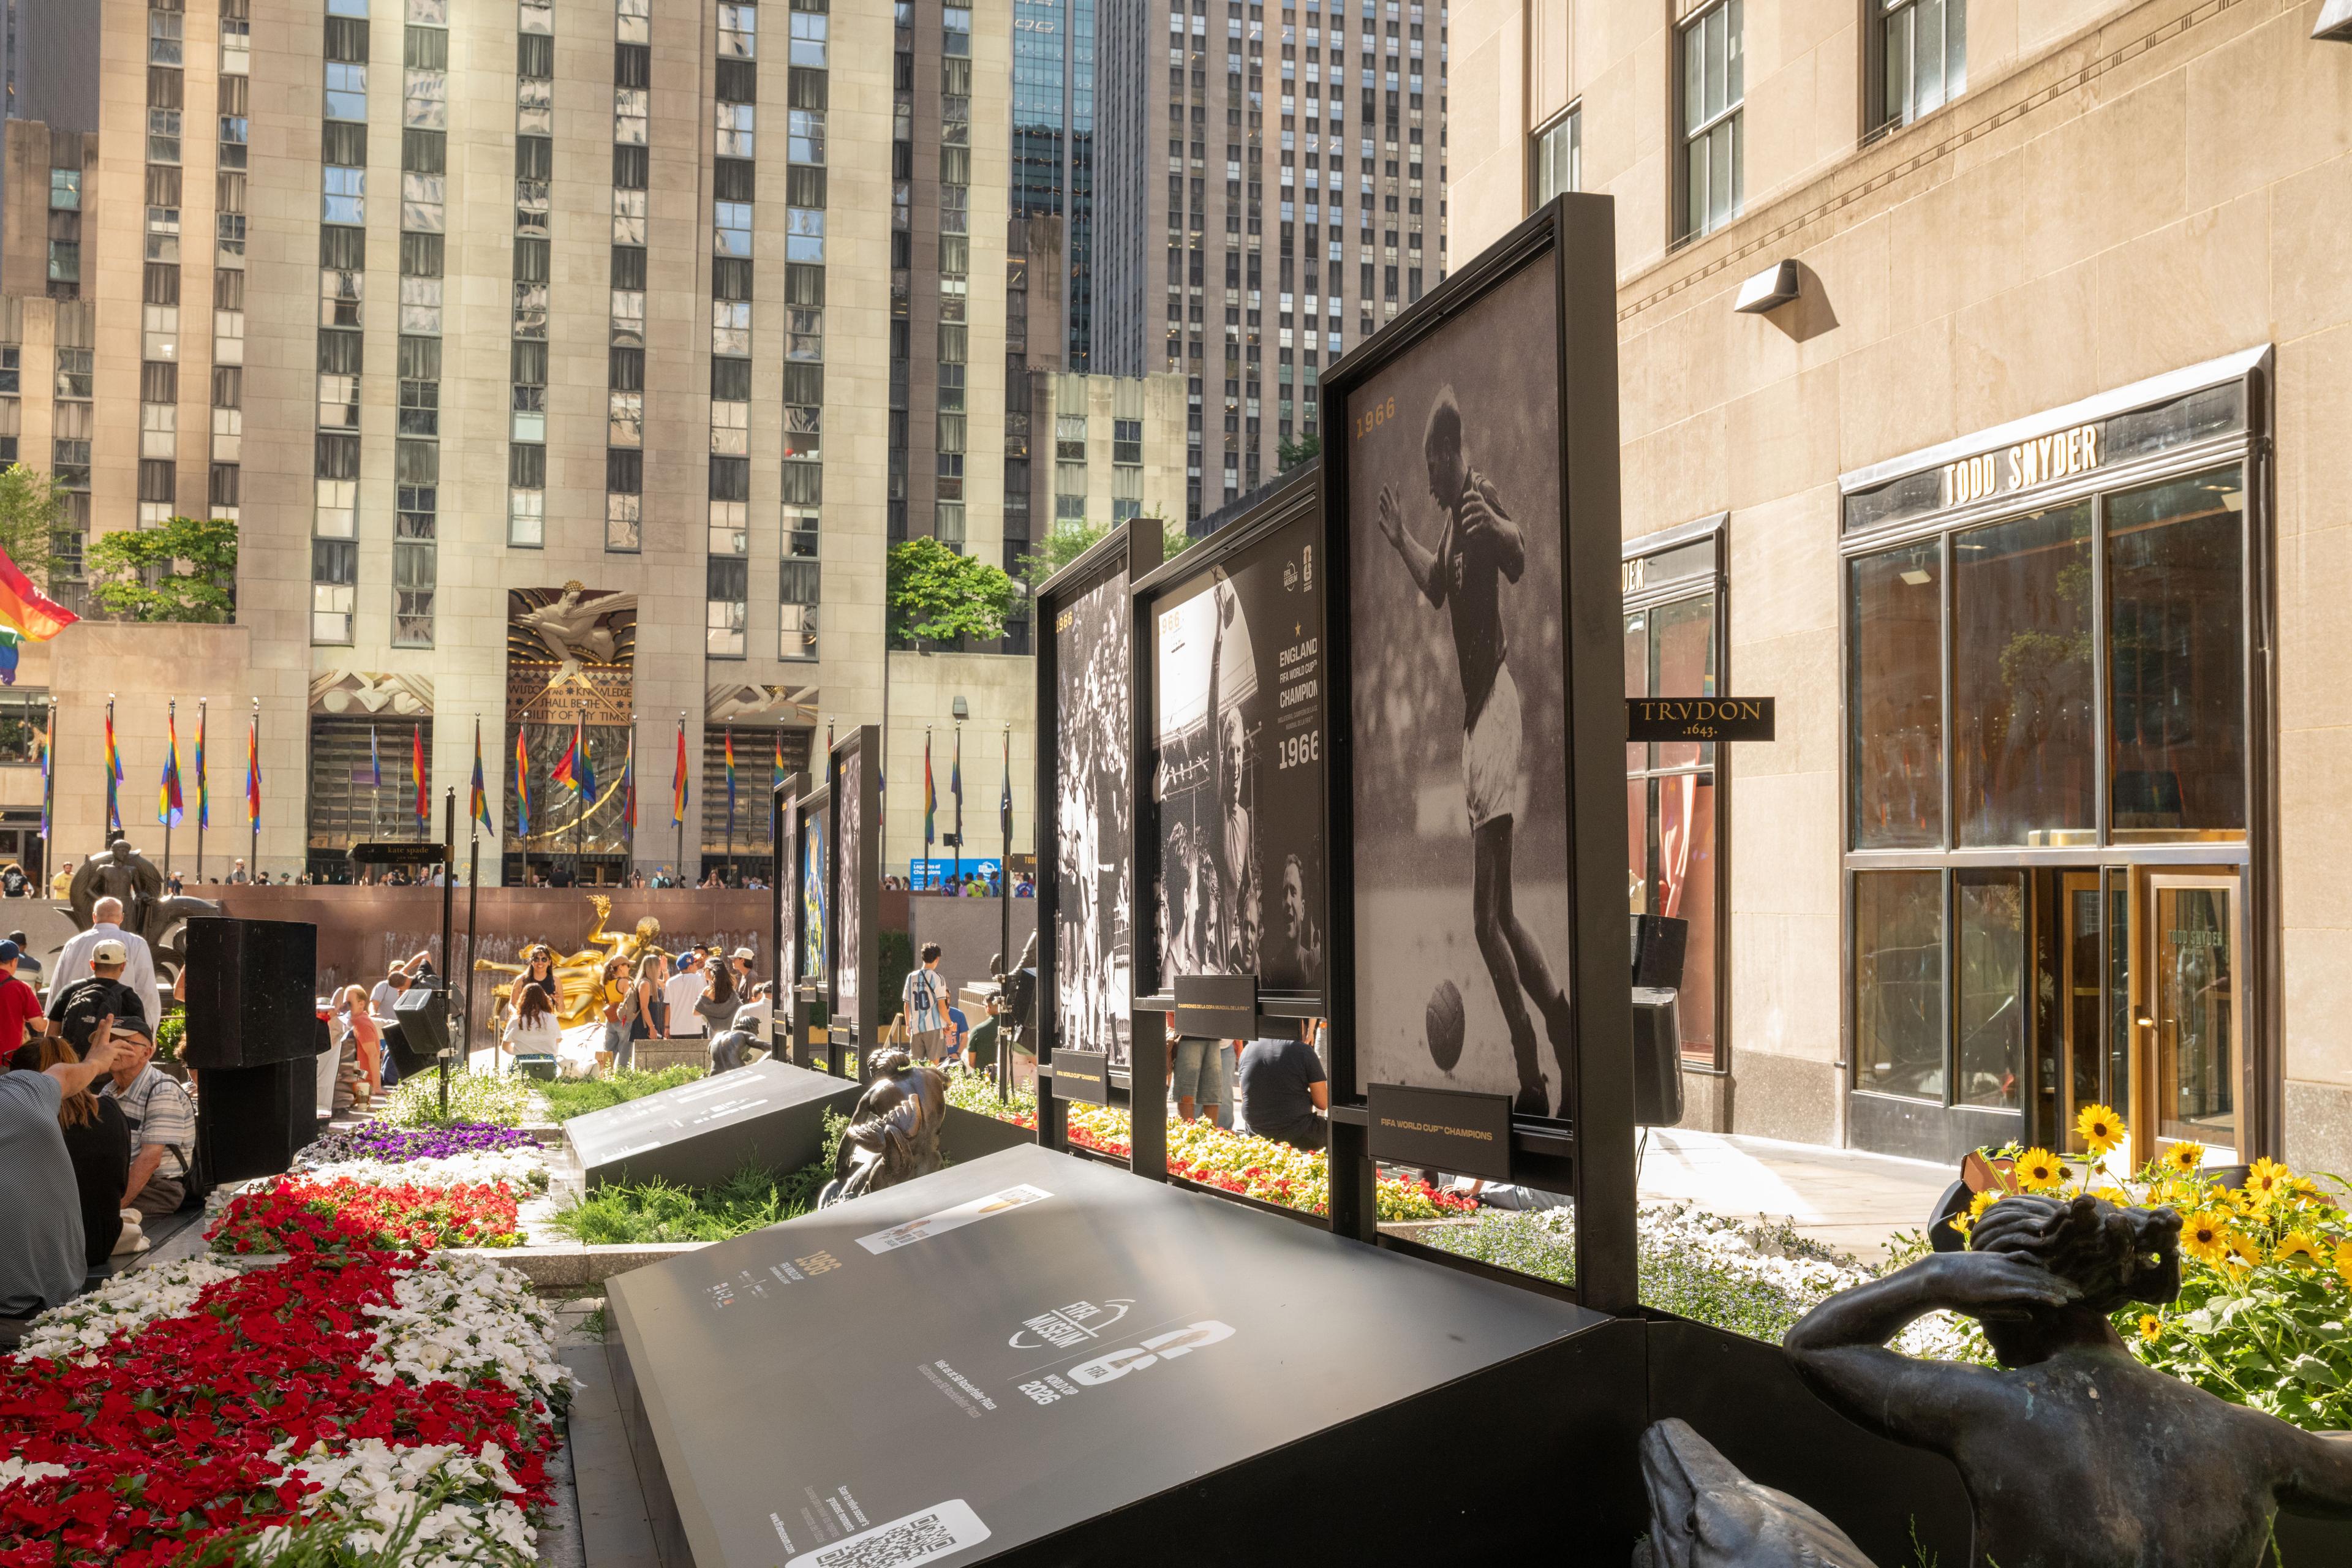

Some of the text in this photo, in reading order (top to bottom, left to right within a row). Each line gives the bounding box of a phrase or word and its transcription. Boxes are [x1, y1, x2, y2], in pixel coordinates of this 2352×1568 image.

[1357, 396, 1395, 439] 1966
[1943, 424, 2098, 506] TODD SNYDER
[1055, 611, 1072, 633] 1966
[1280, 638, 1317, 668] ENGLAND
[1280, 671, 1289, 684] FIFA
[1289, 665, 1305, 680] WORLD
[540, 698, 568, 707] SHALL
[571, 699, 581, 708] BE
[559, 710, 573, 720] OF
[1279, 730, 1318, 770] 1966
[406, 846, 429, 856] spade
[2168, 930, 2223, 946] TODD SNYDER
[913, 990, 930, 1011] 10
[1381, 1118, 1396, 1128] FIFA
[1396, 1120, 1422, 1131] WORLD
[1444, 1126, 1493, 1142] CHAMPIONS
[794, 1250, 843, 1276] 1966
[1060, 1300, 1102, 1321] FIFA
[1022, 1313, 1090, 1349] MUSEUM
[1084, 1365, 1109, 1379] FIFA
[934, 1359, 949, 1370] Visit
[956, 1379, 986, 1400] Rockefeller
[979, 1397, 997, 1411] Plaza
[1017, 1380, 1061, 1406] 2026
[1043, 1373, 1079, 1396] WORLD CUP
[837, 1485, 850, 1496] Scan
[825, 1496, 855, 1532] greatest moments
